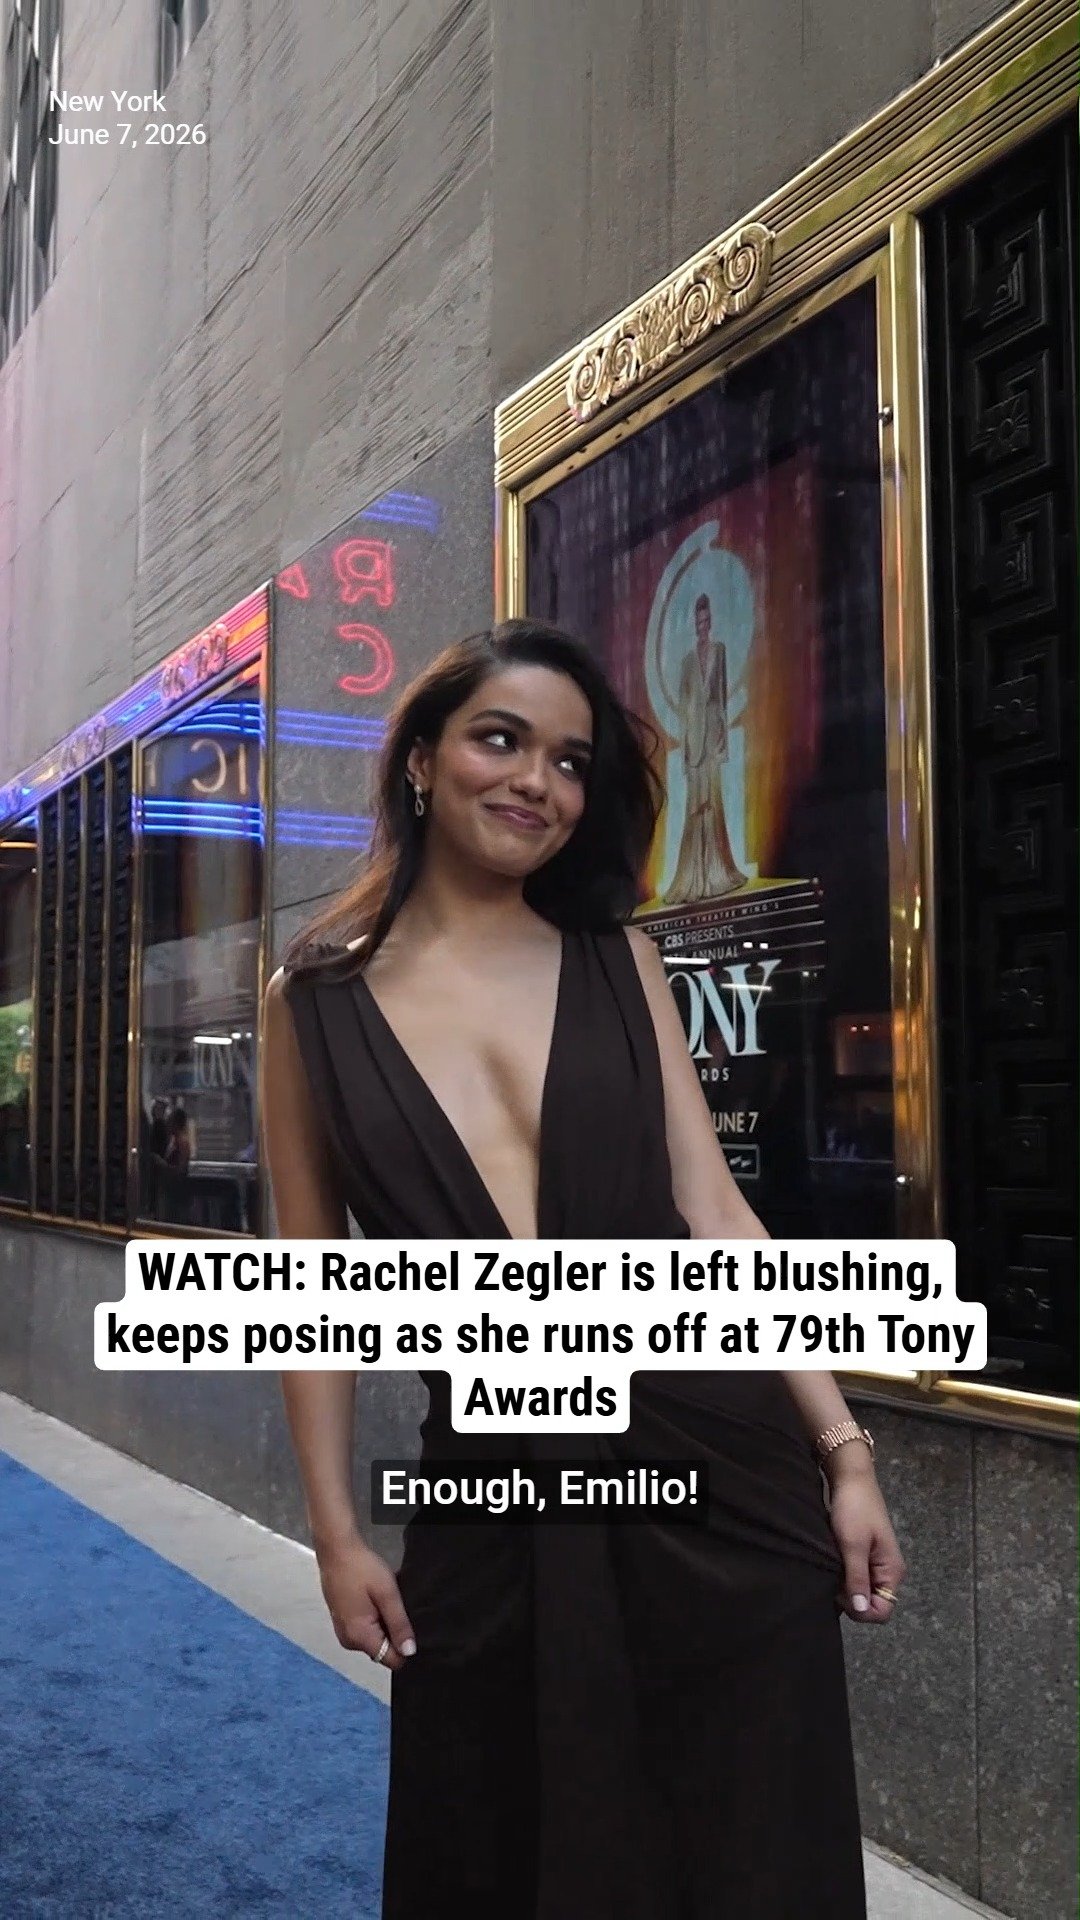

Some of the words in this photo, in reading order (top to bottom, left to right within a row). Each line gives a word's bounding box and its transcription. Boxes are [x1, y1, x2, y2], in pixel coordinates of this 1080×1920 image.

[696, 910, 736, 924] THEATRE
[664, 933, 685, 949] CBS
[685, 925, 735, 943] PRESENTS
[692, 945, 738, 960] ANNUAL
[667, 959, 782, 1059] ONY
[701, 1067, 730, 1081] RDS
[712, 1111, 745, 1133] UNE
[748, 1111, 759, 1133] 7
